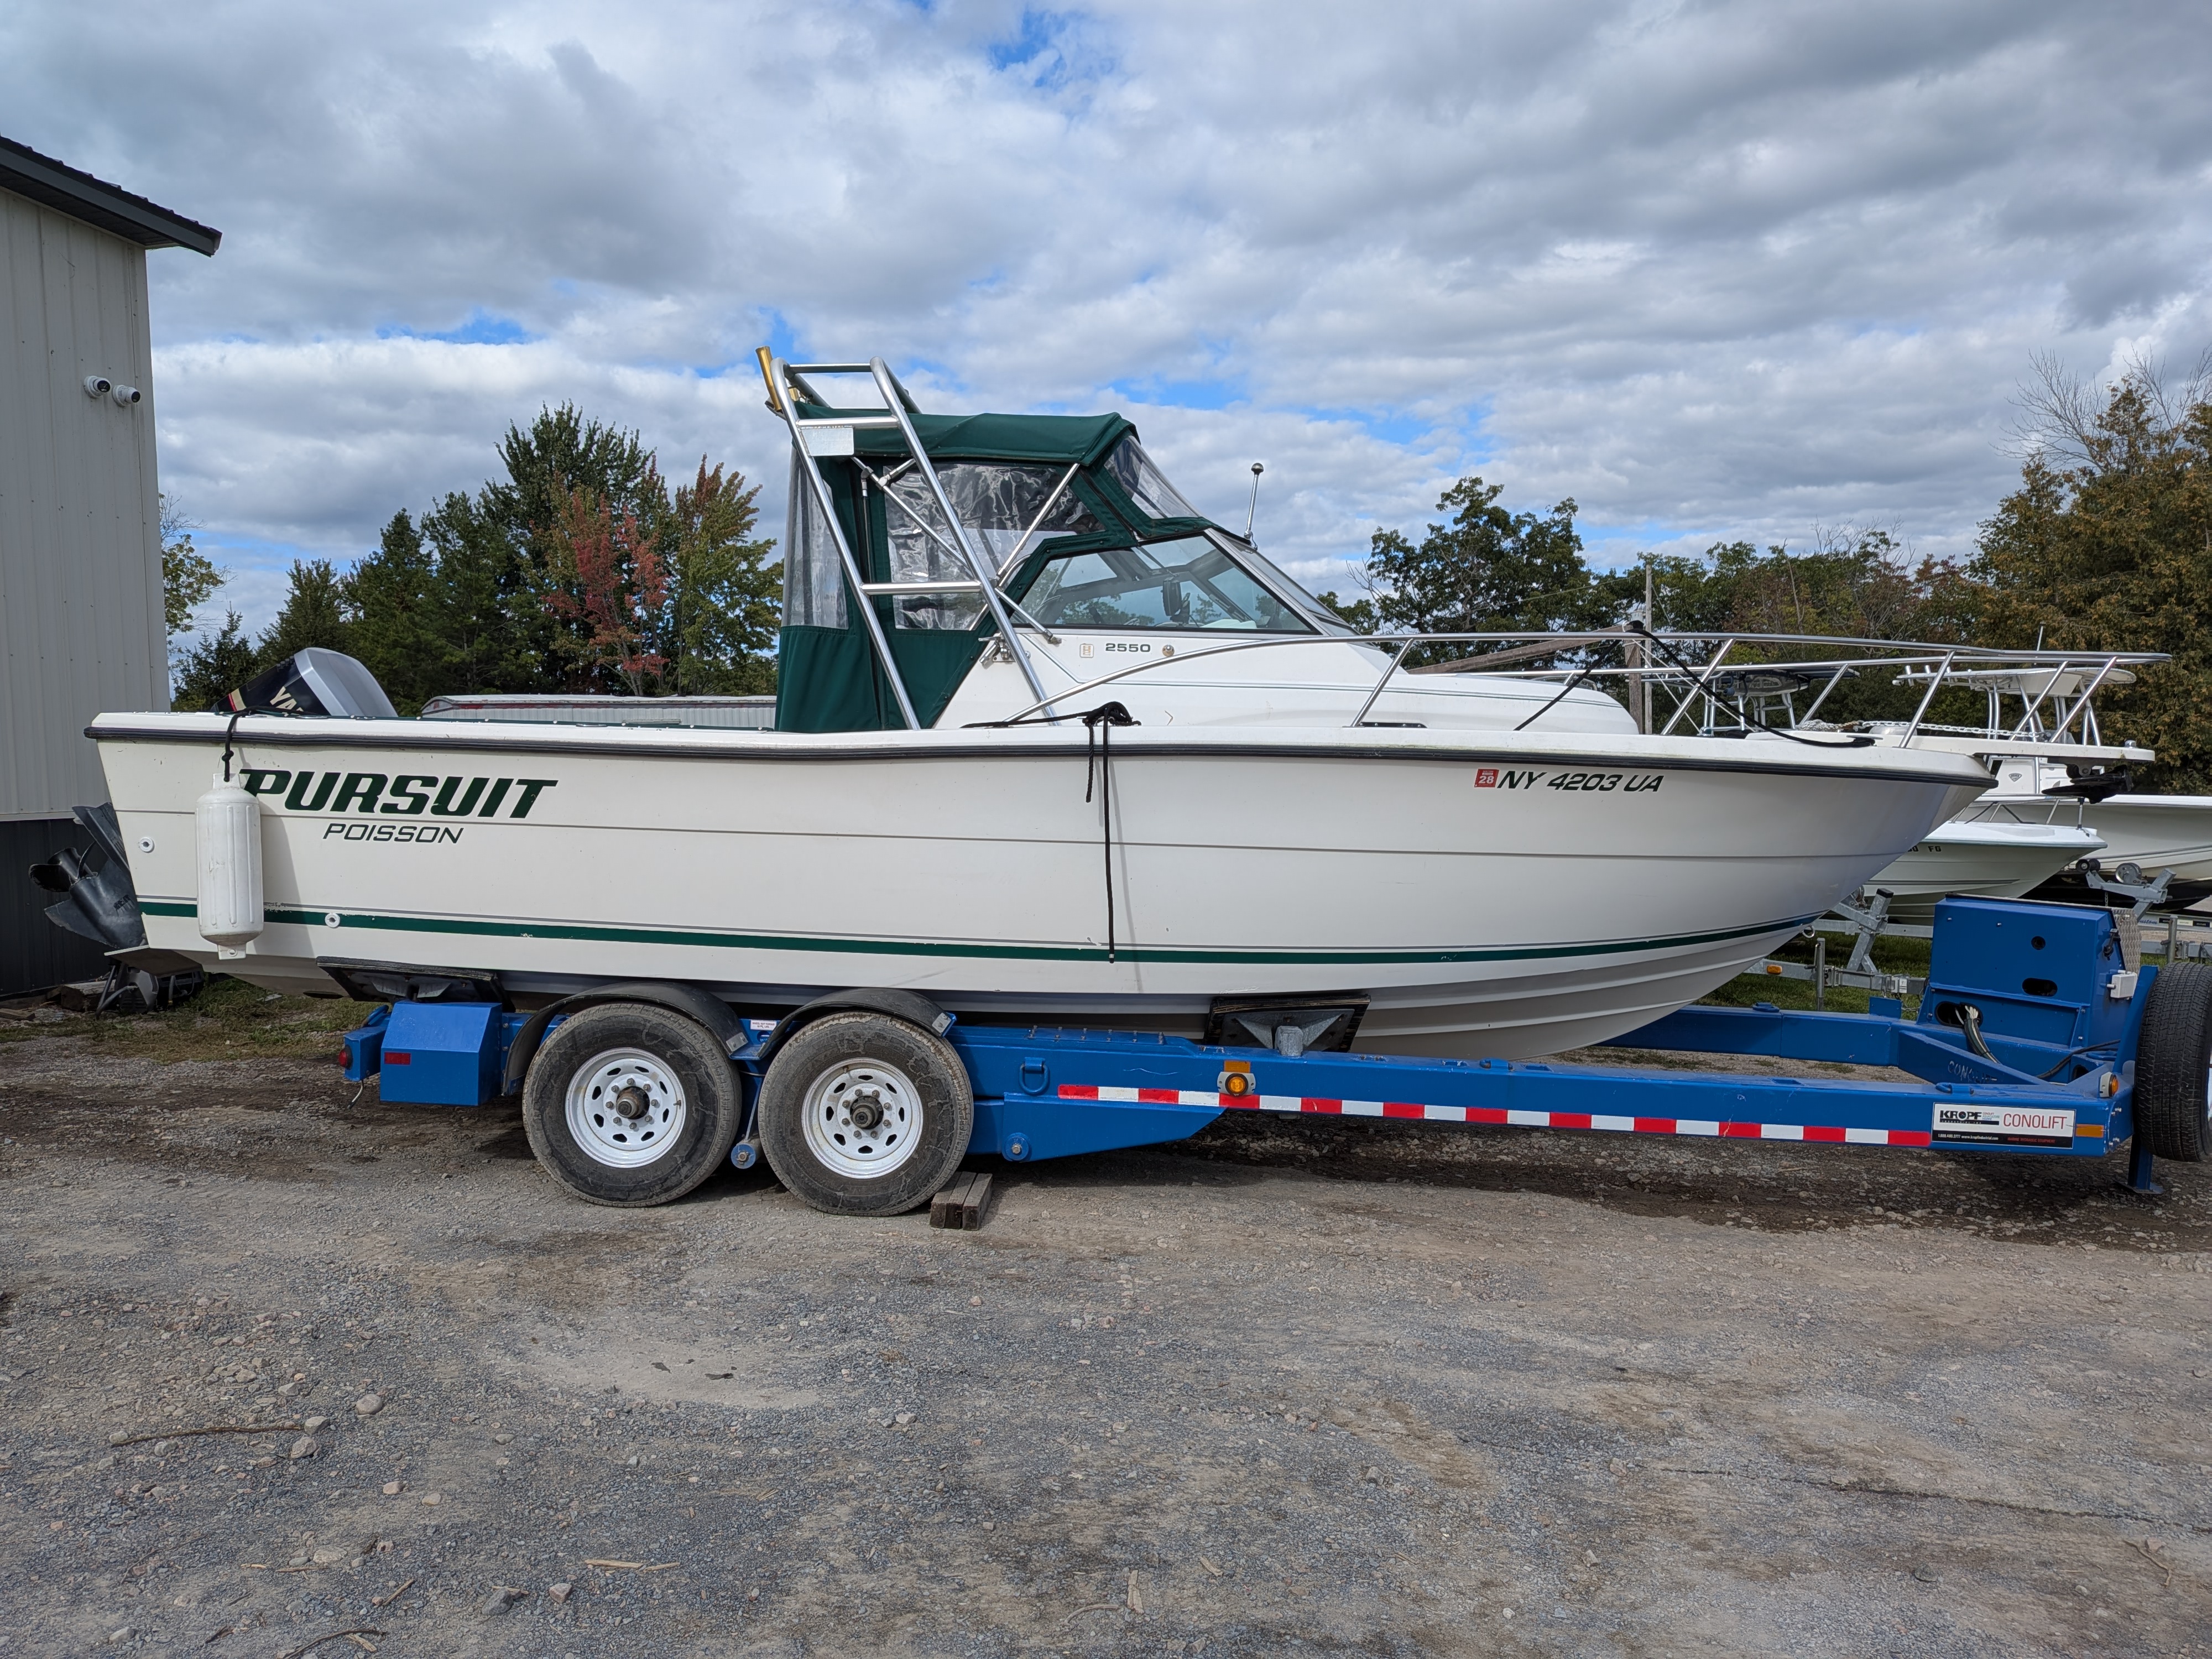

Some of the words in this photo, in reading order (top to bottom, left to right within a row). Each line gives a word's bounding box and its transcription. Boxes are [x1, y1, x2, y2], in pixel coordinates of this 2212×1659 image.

[1105, 643, 1151, 653] 2550
[270, 686, 304, 712] YA
[1478, 775, 1494, 784] 28
[1497, 771, 1547, 789] NY
[1547, 773, 1623, 791] 4203
[1624, 775, 1664, 792] UA
[239, 769, 559, 818] PURSUIT
[323, 823, 464, 844] POISSON
[1940, 1110, 1982, 1120] KROPF
[2004, 1113, 2067, 1129] CONOLIFT
